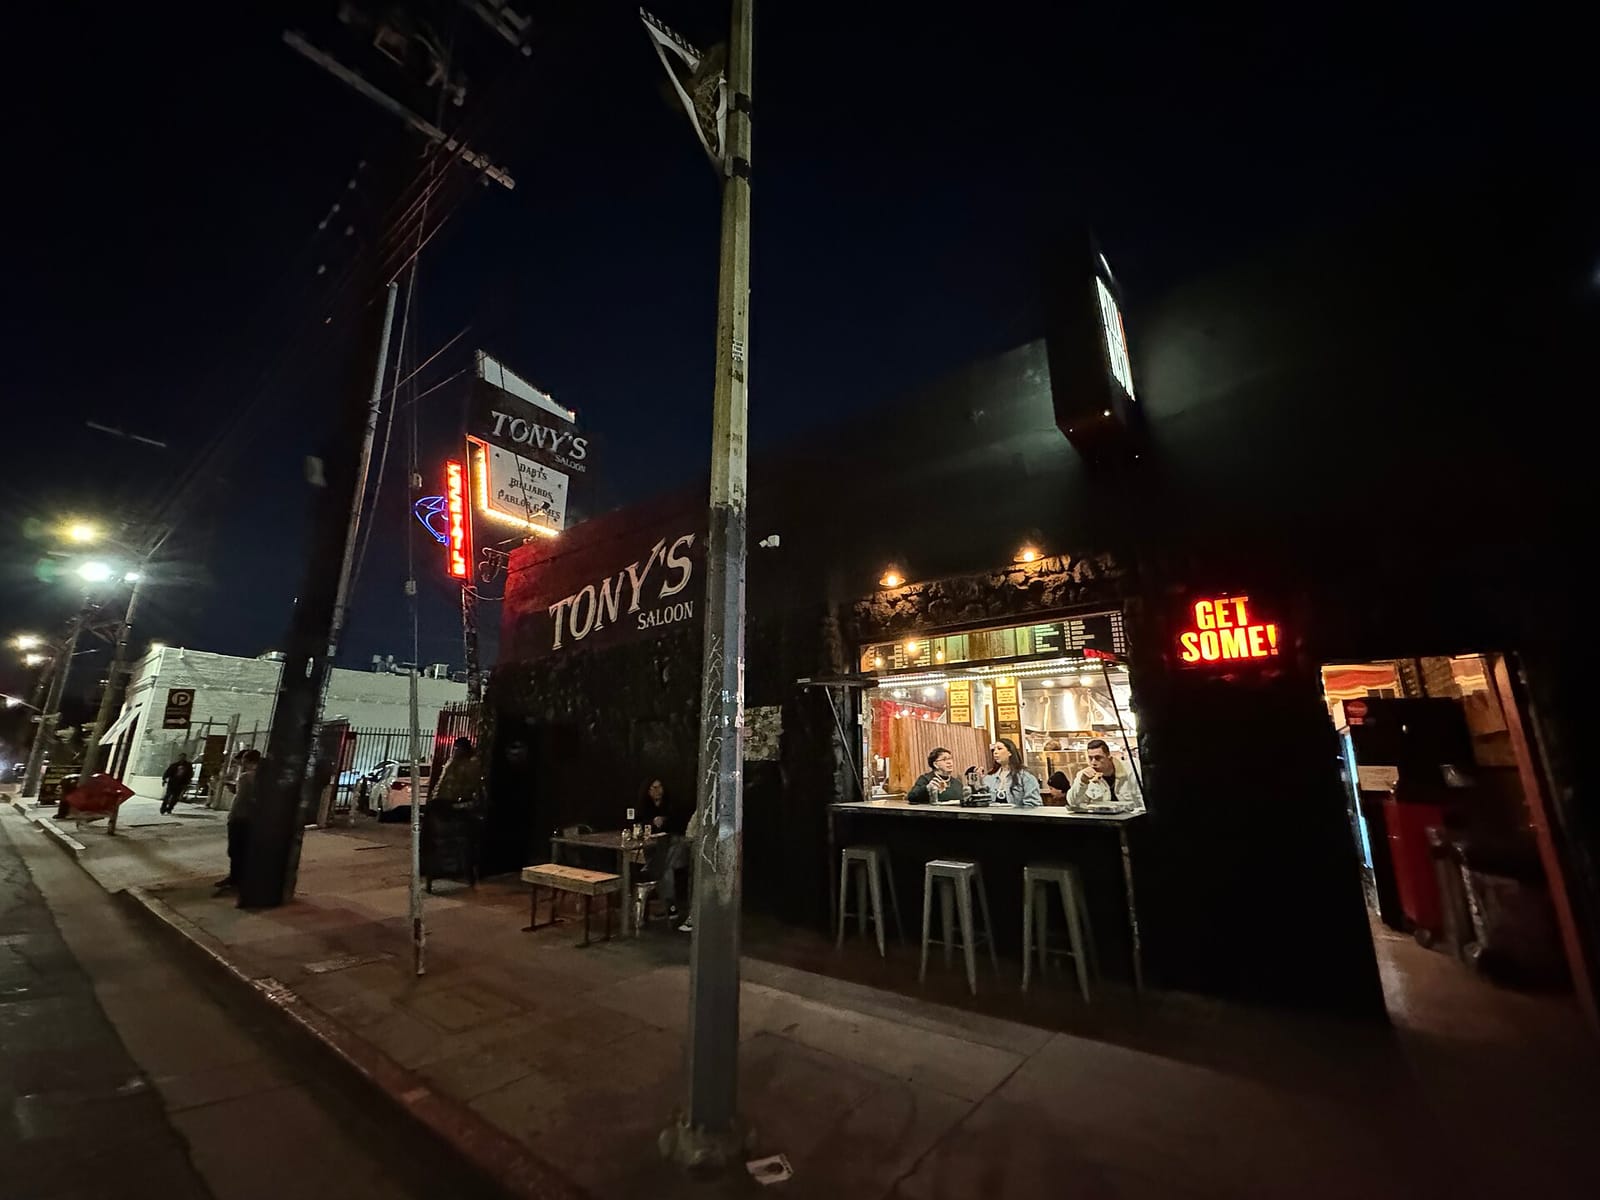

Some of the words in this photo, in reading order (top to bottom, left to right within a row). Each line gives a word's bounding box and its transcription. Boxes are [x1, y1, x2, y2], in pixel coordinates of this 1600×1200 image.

[491, 410, 589, 460] TONY'S
[519, 463, 548, 480] DARTS
[555, 454, 586, 472] SALOON
[498, 489, 531, 511] PARLOR
[510, 477, 553, 500] BILLIARDS
[549, 533, 695, 650] TONY'S
[637, 601, 694, 630] SALOON
[1195, 596, 1249, 630] GET
[1180, 624, 1279, 662] SOME!
